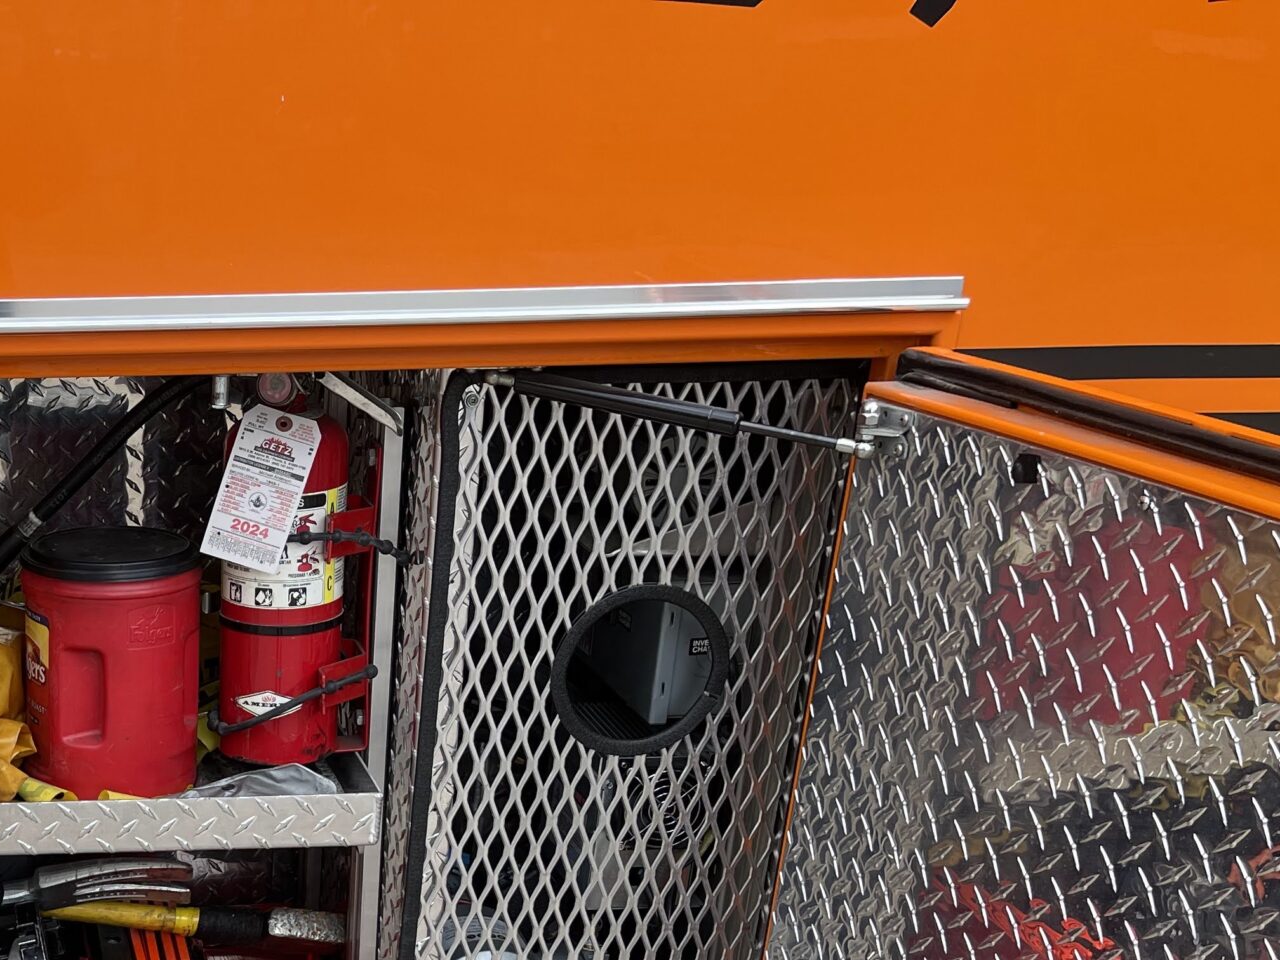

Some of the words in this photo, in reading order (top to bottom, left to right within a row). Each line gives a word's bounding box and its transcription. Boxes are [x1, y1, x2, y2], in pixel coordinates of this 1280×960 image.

[261, 440, 293, 456] GETZ
[230, 518, 270, 540] 2024
[326, 575, 333, 591] C
[25, 656, 46, 684] gers
[242, 700, 279, 708] AMER
